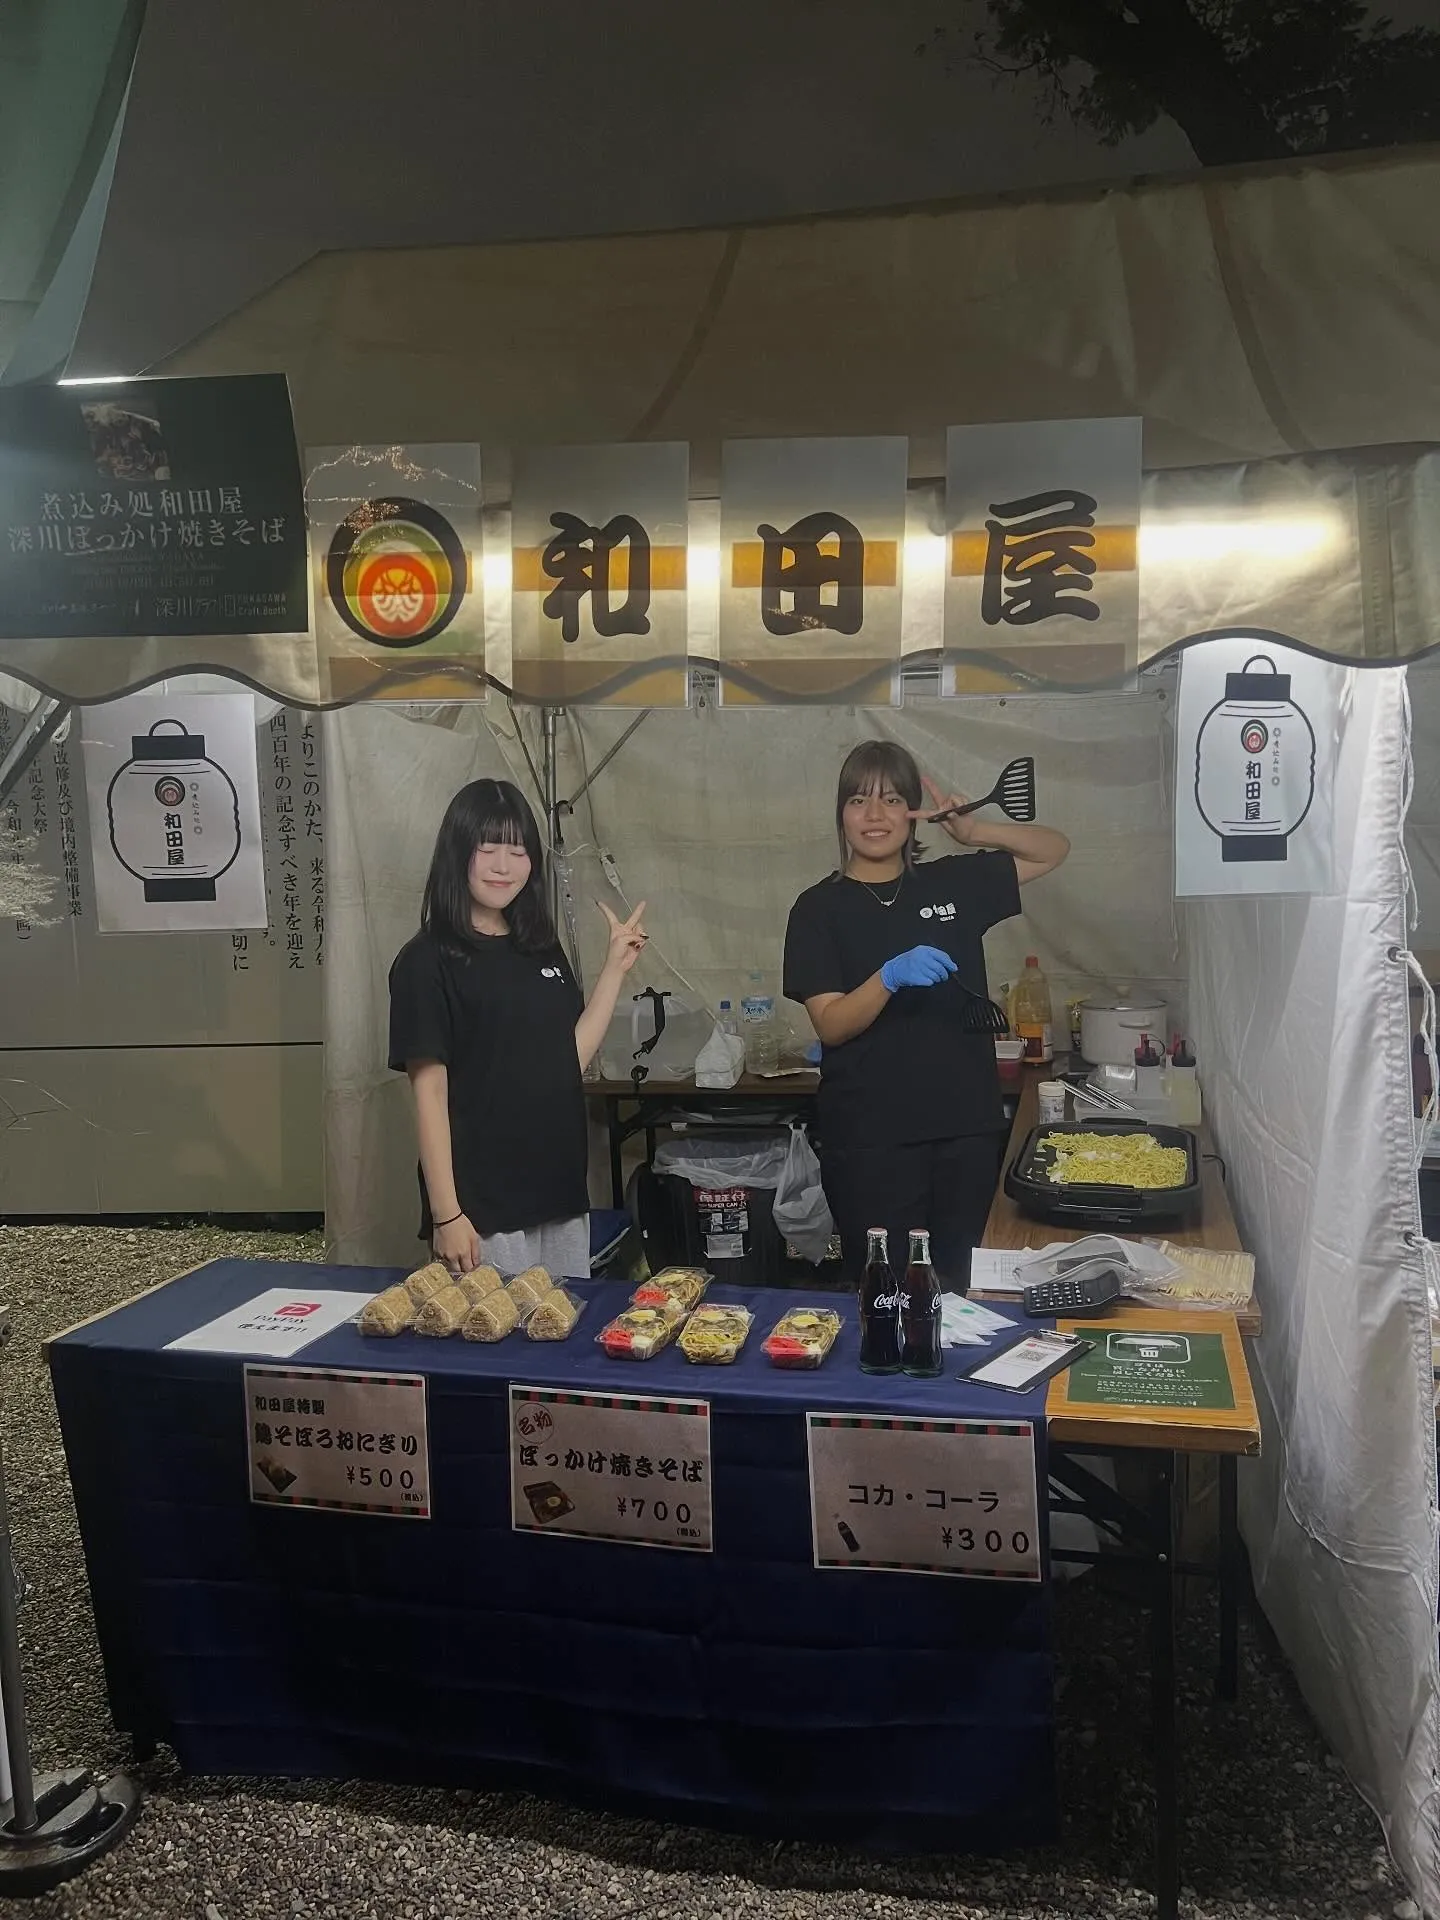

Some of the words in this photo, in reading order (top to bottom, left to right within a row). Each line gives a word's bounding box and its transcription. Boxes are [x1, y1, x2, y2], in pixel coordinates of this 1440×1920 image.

[40, 487, 243, 521] 煮込み処和田屋
[8, 518, 286, 553] 深川ぼっかけ焼きそば
[542, 490, 1100, 642] 和田屋
[1245, 760, 1261, 820] 和田屋
[53, 741, 83, 917] 改修及び境内整備事業
[164, 812, 185, 866] 和田屋
[253, 1315, 306, 1323] PayPay
[254, 1422, 418, 1456] 鶏そぼろおにぎり
[518, 1410, 553, 1436] 名物
[346, 1465, 414, 1489] ¥500
[519, 1444, 703, 1483] ぼっかけ焼きそば
[617, 1496, 691, 1524] ¥700
[848, 1483, 1000, 1513] コカ・コーラ
[941, 1526, 1030, 1554] ¥300
